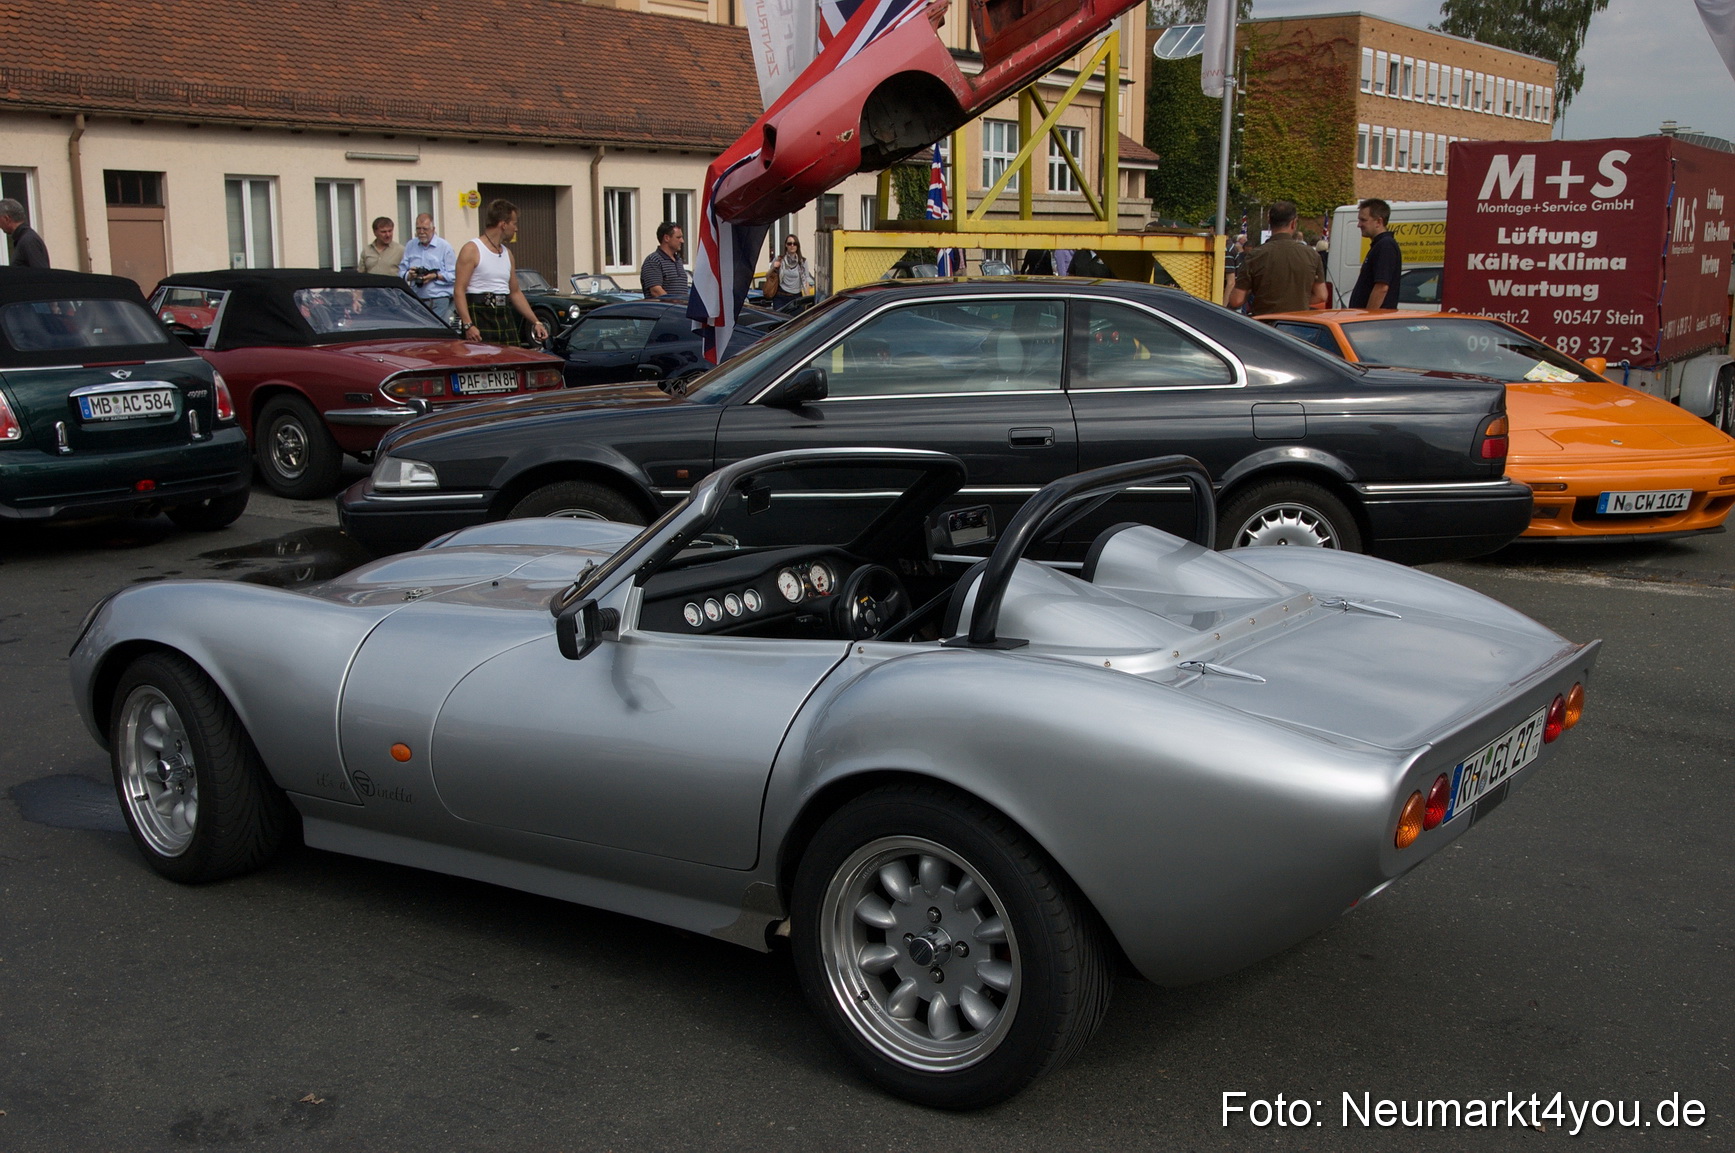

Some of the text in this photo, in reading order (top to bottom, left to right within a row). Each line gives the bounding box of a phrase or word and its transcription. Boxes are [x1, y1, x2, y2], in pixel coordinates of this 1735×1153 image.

[1477, 150, 1632, 200] M+S
[1477, 199, 1634, 216] Montage+Service GmbH
[1497, 226, 1598, 248] Lüftung
[1467, 252, 1627, 271] Kälte-Klima
[1488, 279, 1599, 302] Wartung
[1553, 310, 1601, 325] 90547
[1606, 309, 1644, 325] Stein
[1556, 336, 1581, 354] 89
[1588, 337, 1614, 354] 37
[459, 371, 517, 389] PAF FN 8H
[91, 393, 172, 415] MB AC 584
[1613, 493, 1685, 510] N CW 101
[1455, 755, 1485, 809] RH
[1511, 719, 1536, 770] 27
